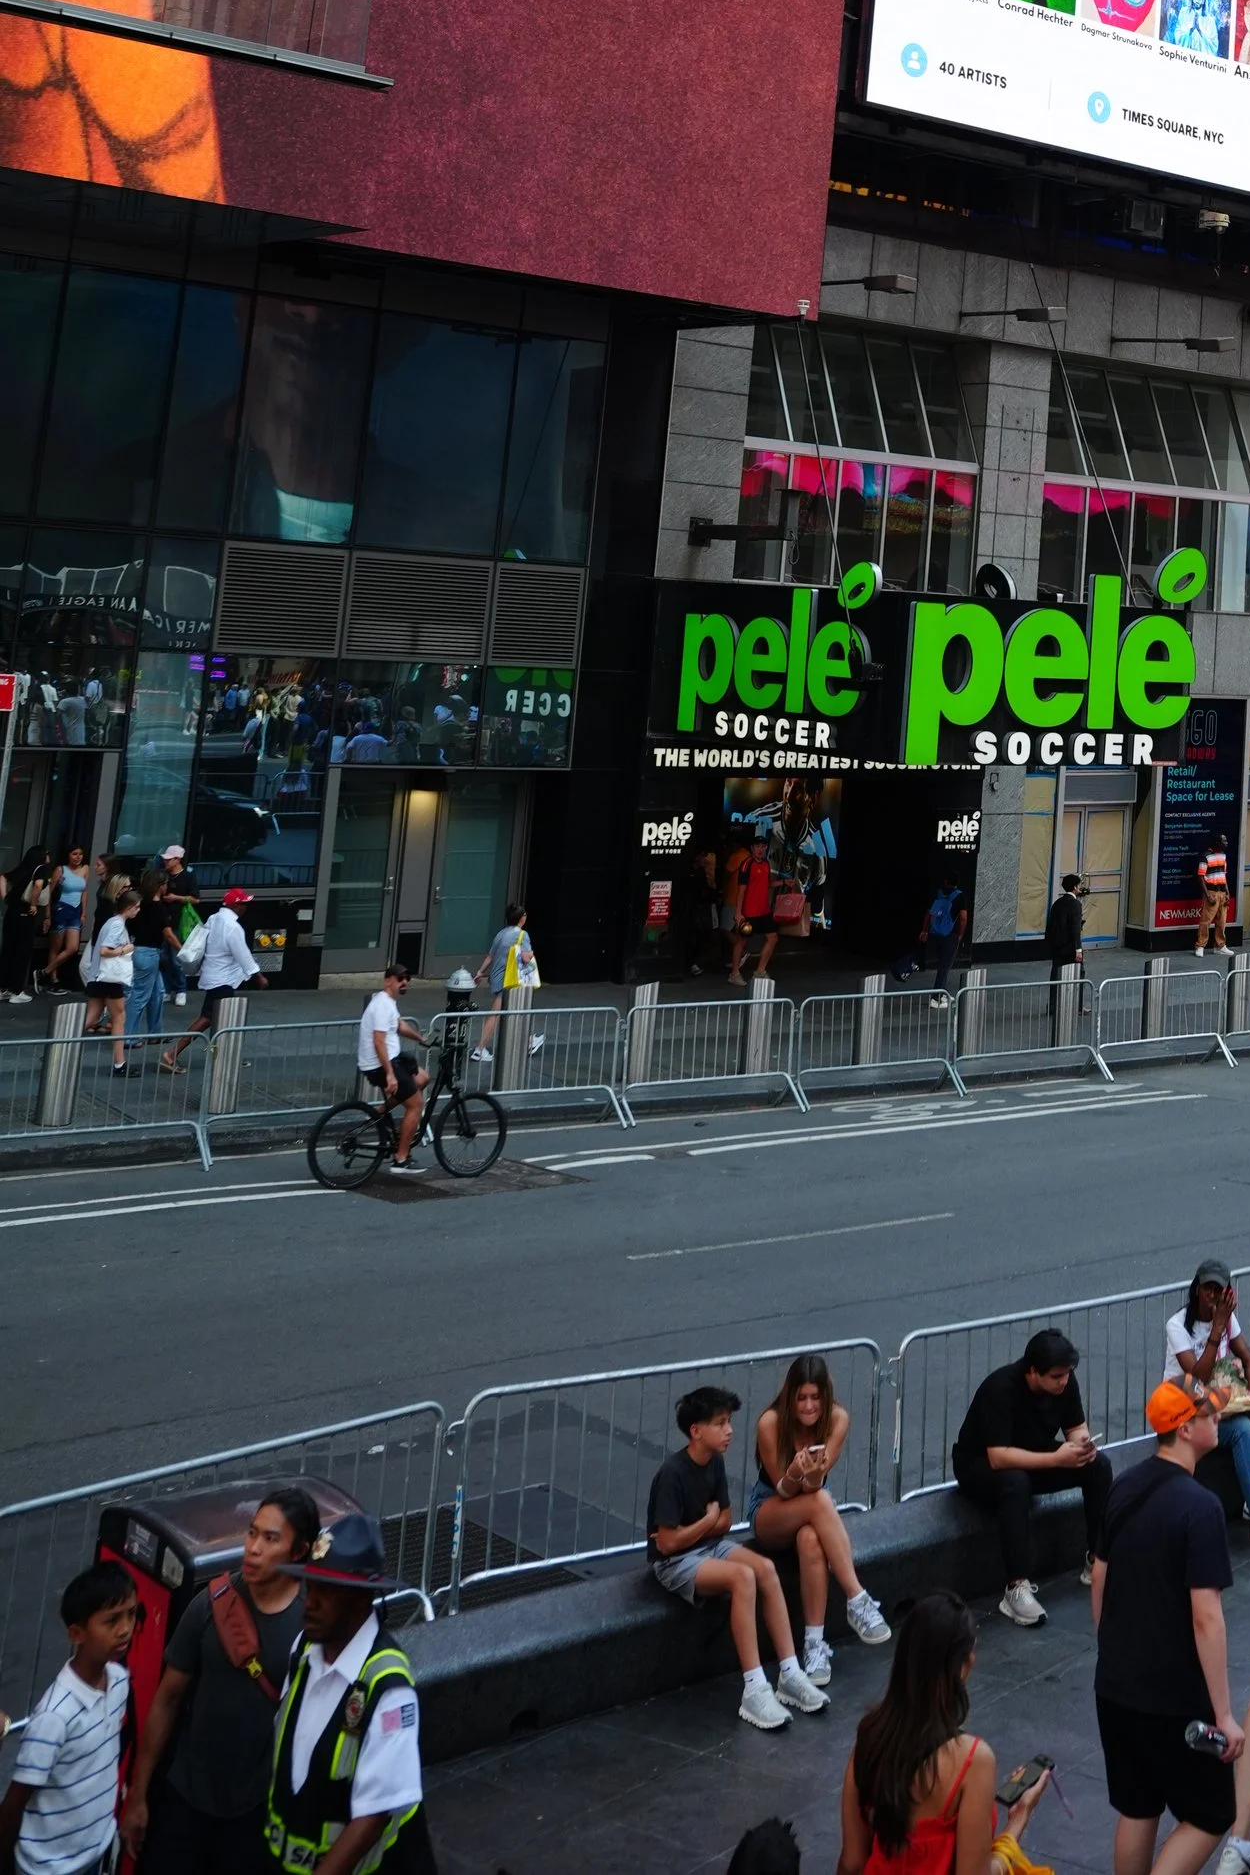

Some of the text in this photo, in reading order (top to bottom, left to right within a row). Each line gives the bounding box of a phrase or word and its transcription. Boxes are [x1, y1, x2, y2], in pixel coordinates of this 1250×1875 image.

[1037, 9, 1074, 28] Hechter
[939, 61, 1007, 89] 40 ARTISTS
[1122, 108, 1224, 145] TIMES SQUARE, NYC
[677, 561, 883, 733] pelé
[904, 547, 1208, 767] pelé
[714, 710, 833, 749] SOCCER
[654, 748, 690, 767] THE
[694, 749, 771, 769] WORLD'S
[973, 730, 1155, 766] SOCCER
[1167, 765, 1197, 777] Retail/
[1167, 778, 1216, 790] Restaurant
[1166, 790, 1234, 804] Space for Lease
[641, 811, 694, 847] pelé
[937, 810, 981, 842] pelé
[651, 839, 686, 847] SOCCER
[1159, 907, 1201, 920] NEWMARK
